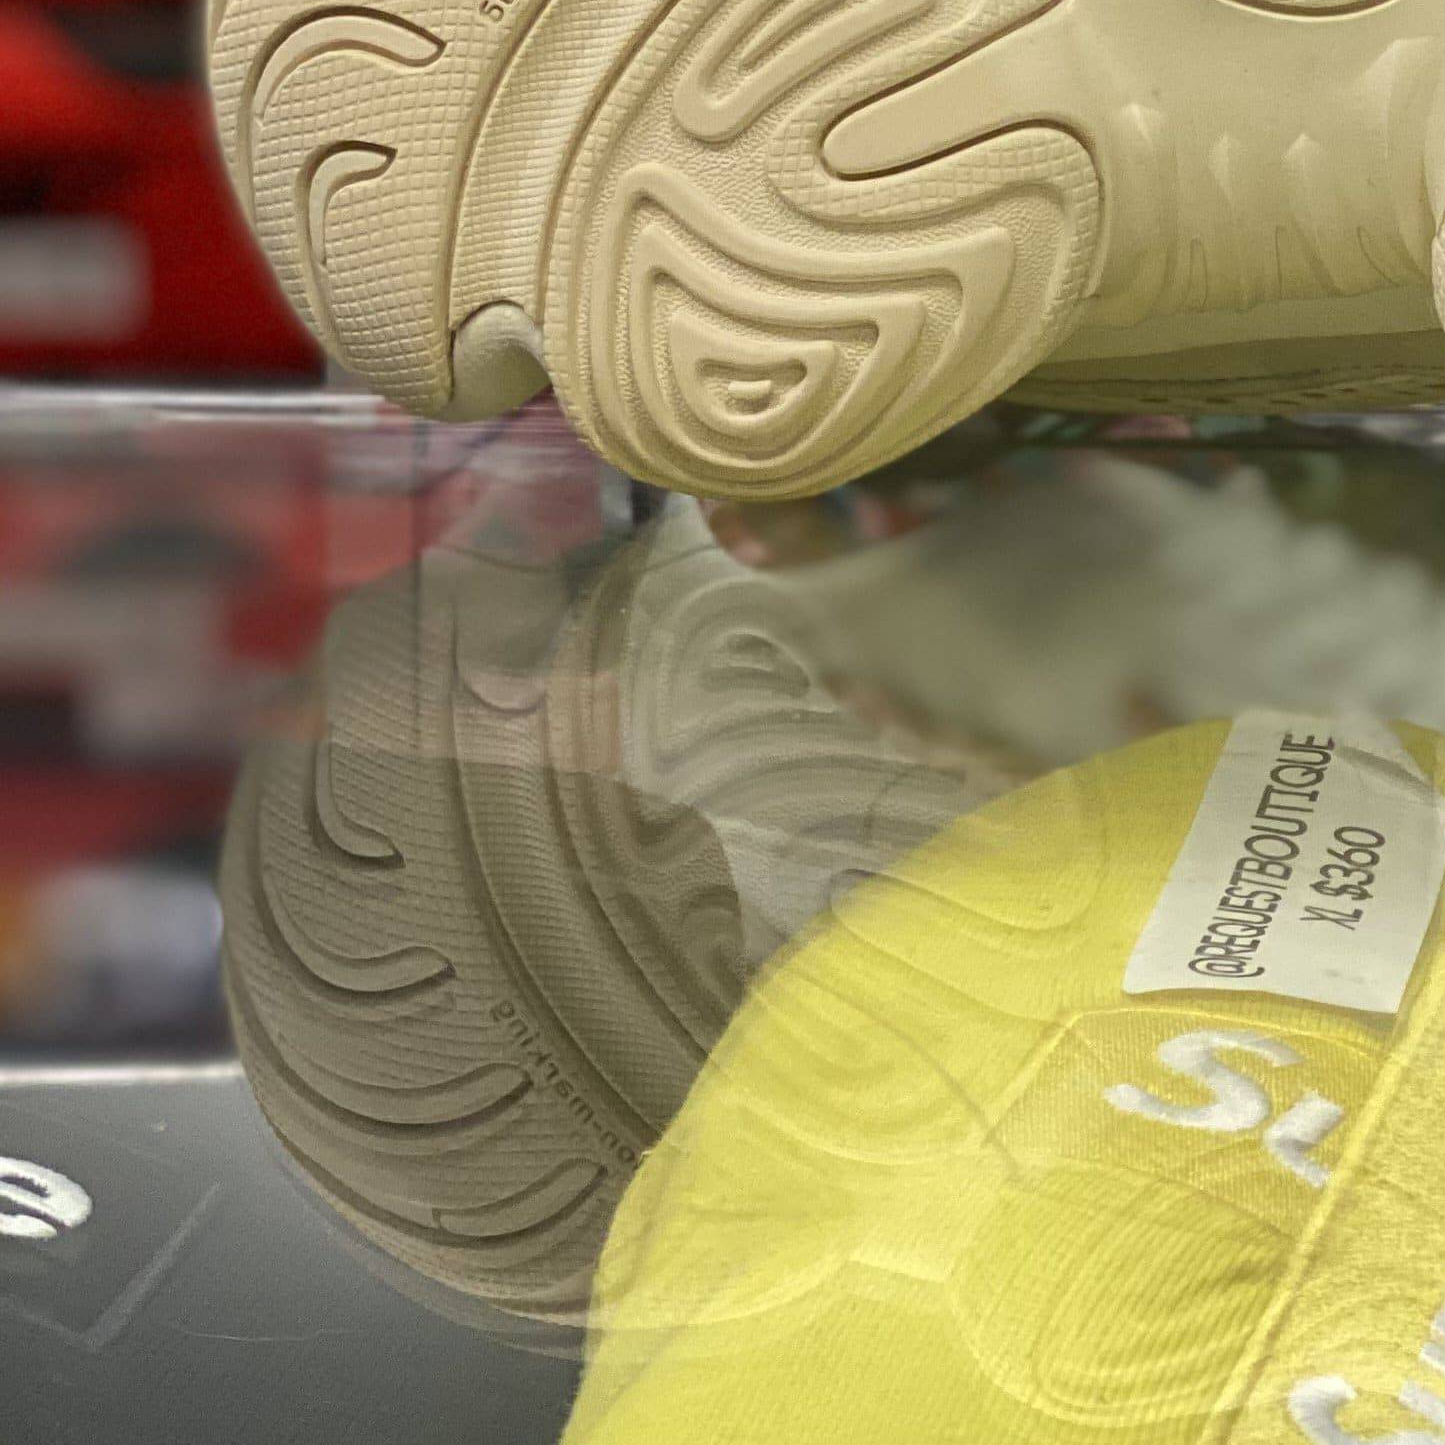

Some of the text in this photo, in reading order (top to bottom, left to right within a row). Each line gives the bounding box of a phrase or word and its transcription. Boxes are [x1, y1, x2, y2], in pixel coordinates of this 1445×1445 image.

[1187, 732, 1336, 978] @REQUESTBOUTIQUE
[1299, 825, 1387, 931] XL $360
